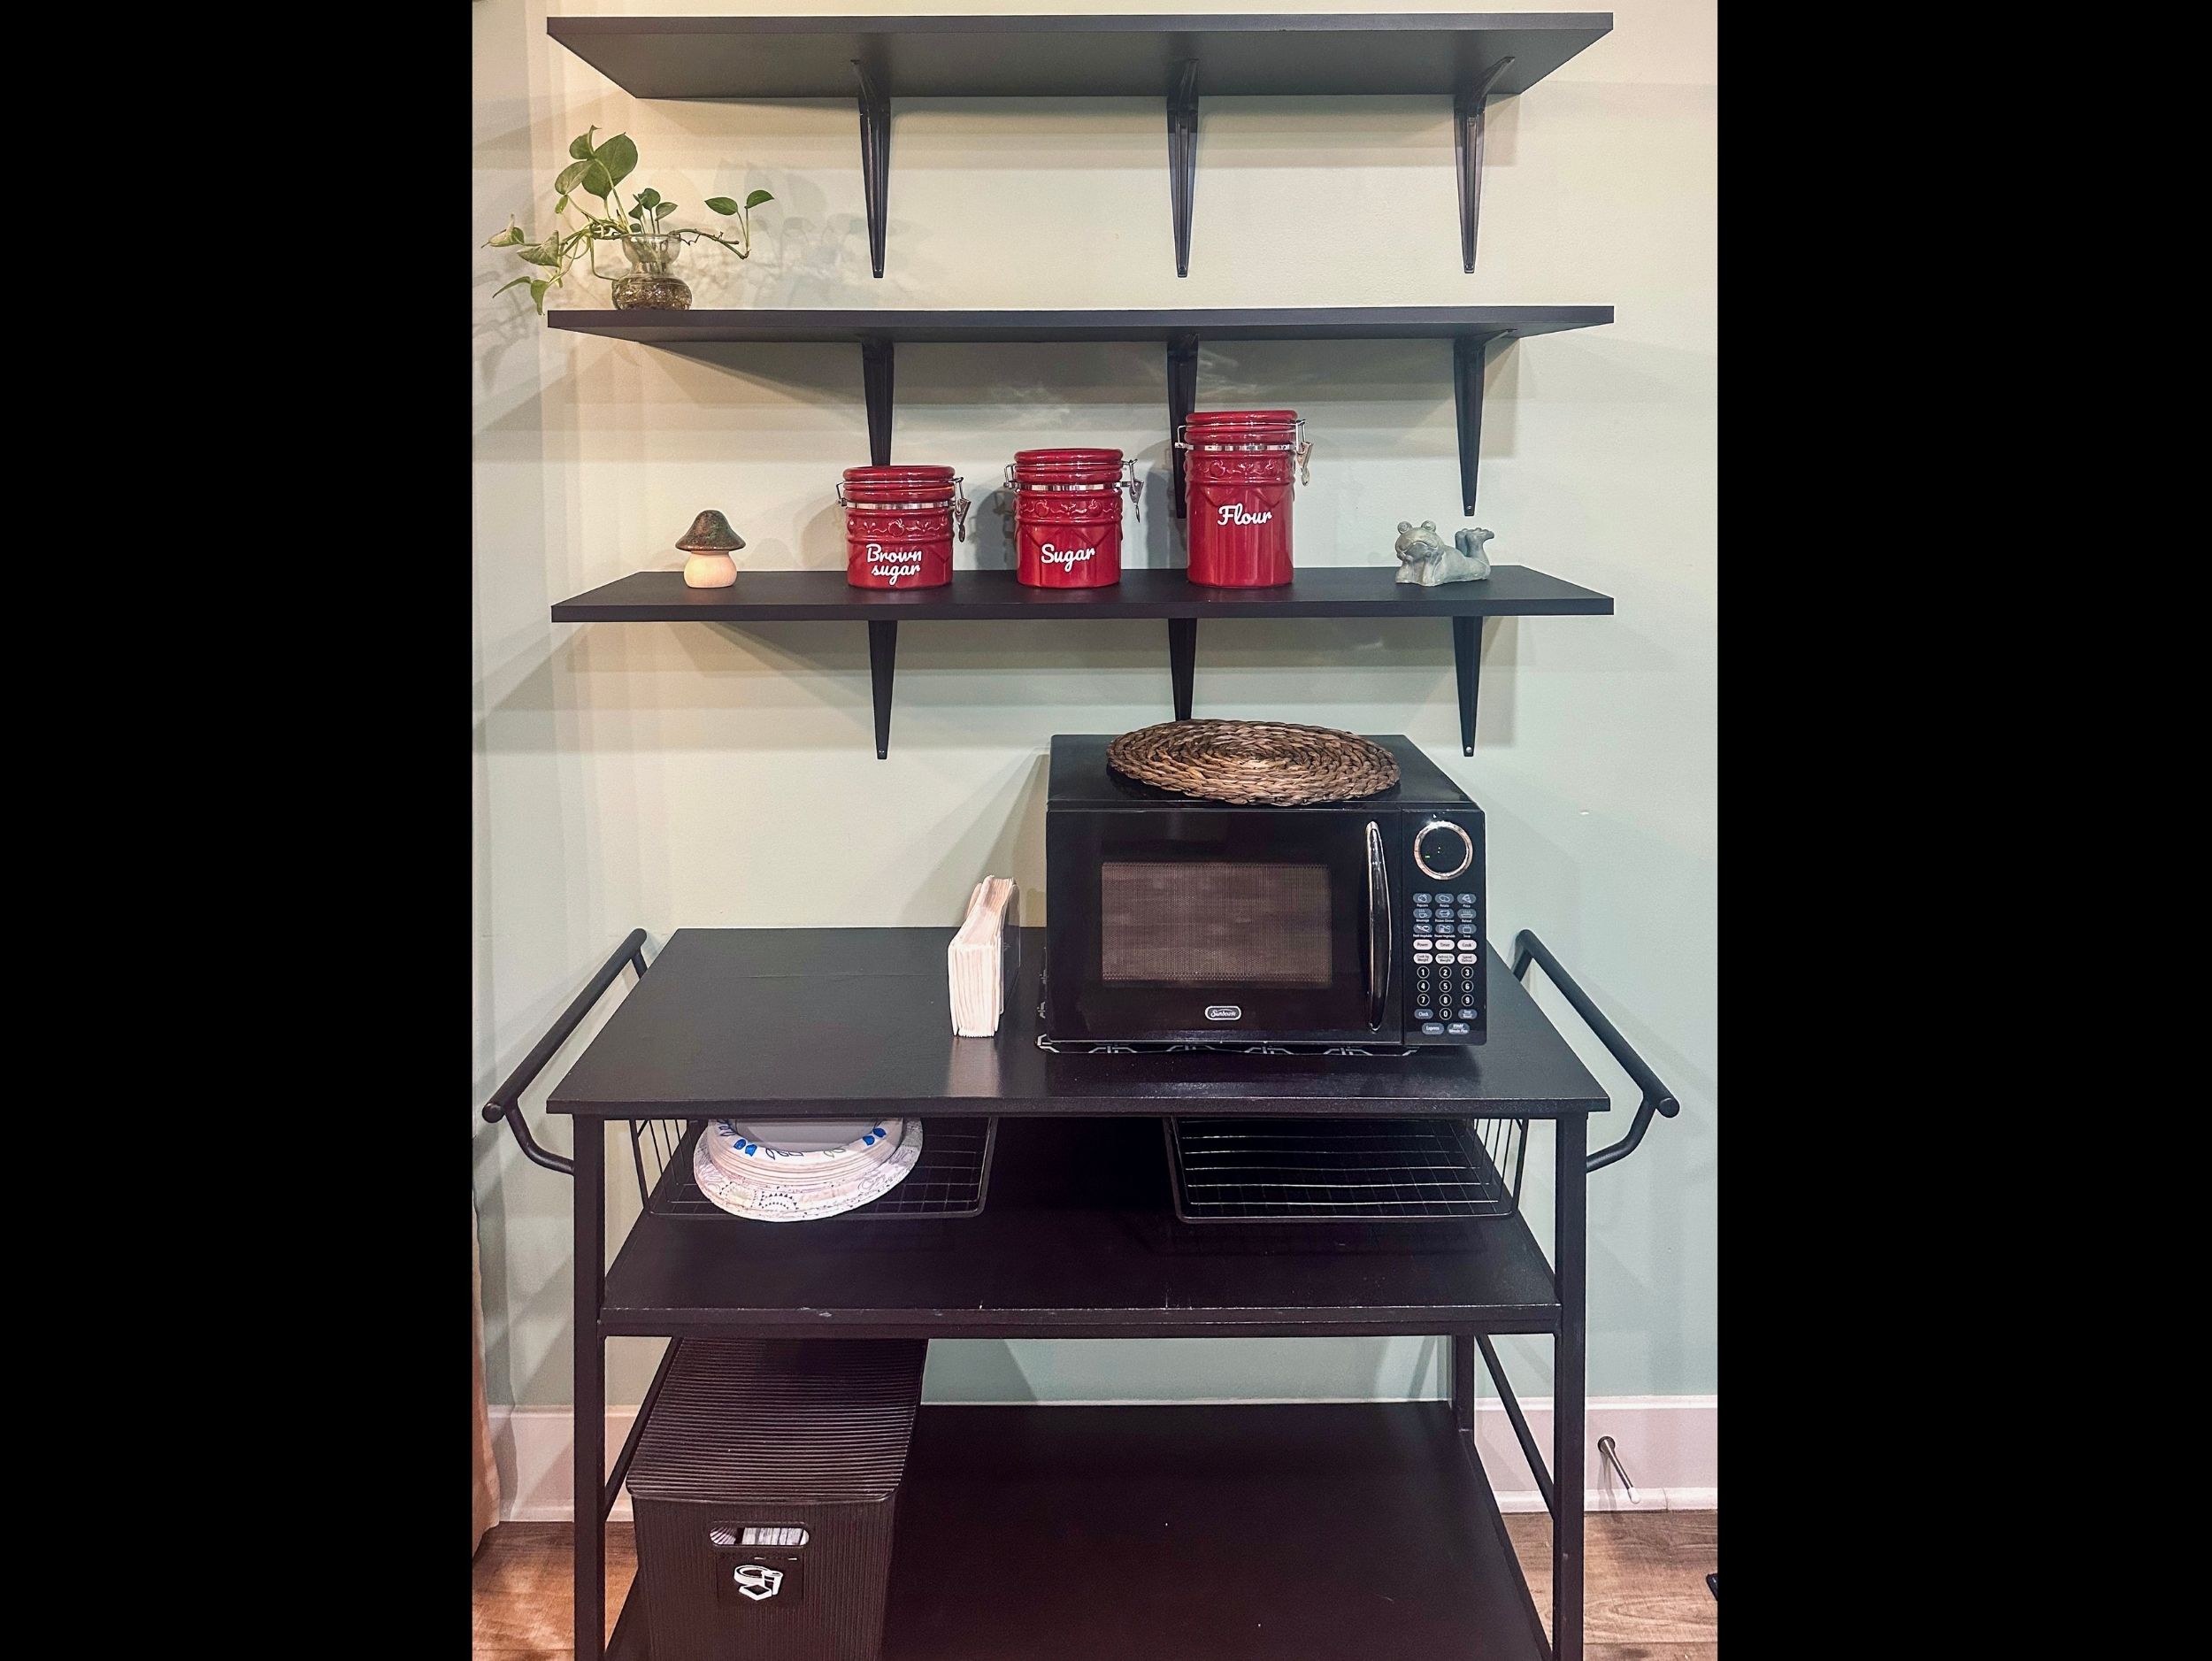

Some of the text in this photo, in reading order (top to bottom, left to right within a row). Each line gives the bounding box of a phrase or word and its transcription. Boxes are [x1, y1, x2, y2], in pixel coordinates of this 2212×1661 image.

[1217, 503, 1272, 525] Flour
[866, 543, 923, 563] Brown
[1041, 543, 1095, 573] Sugar
[872, 564, 921, 585] sugar
[1210, 1009, 1236, 1018] Sunbeam
